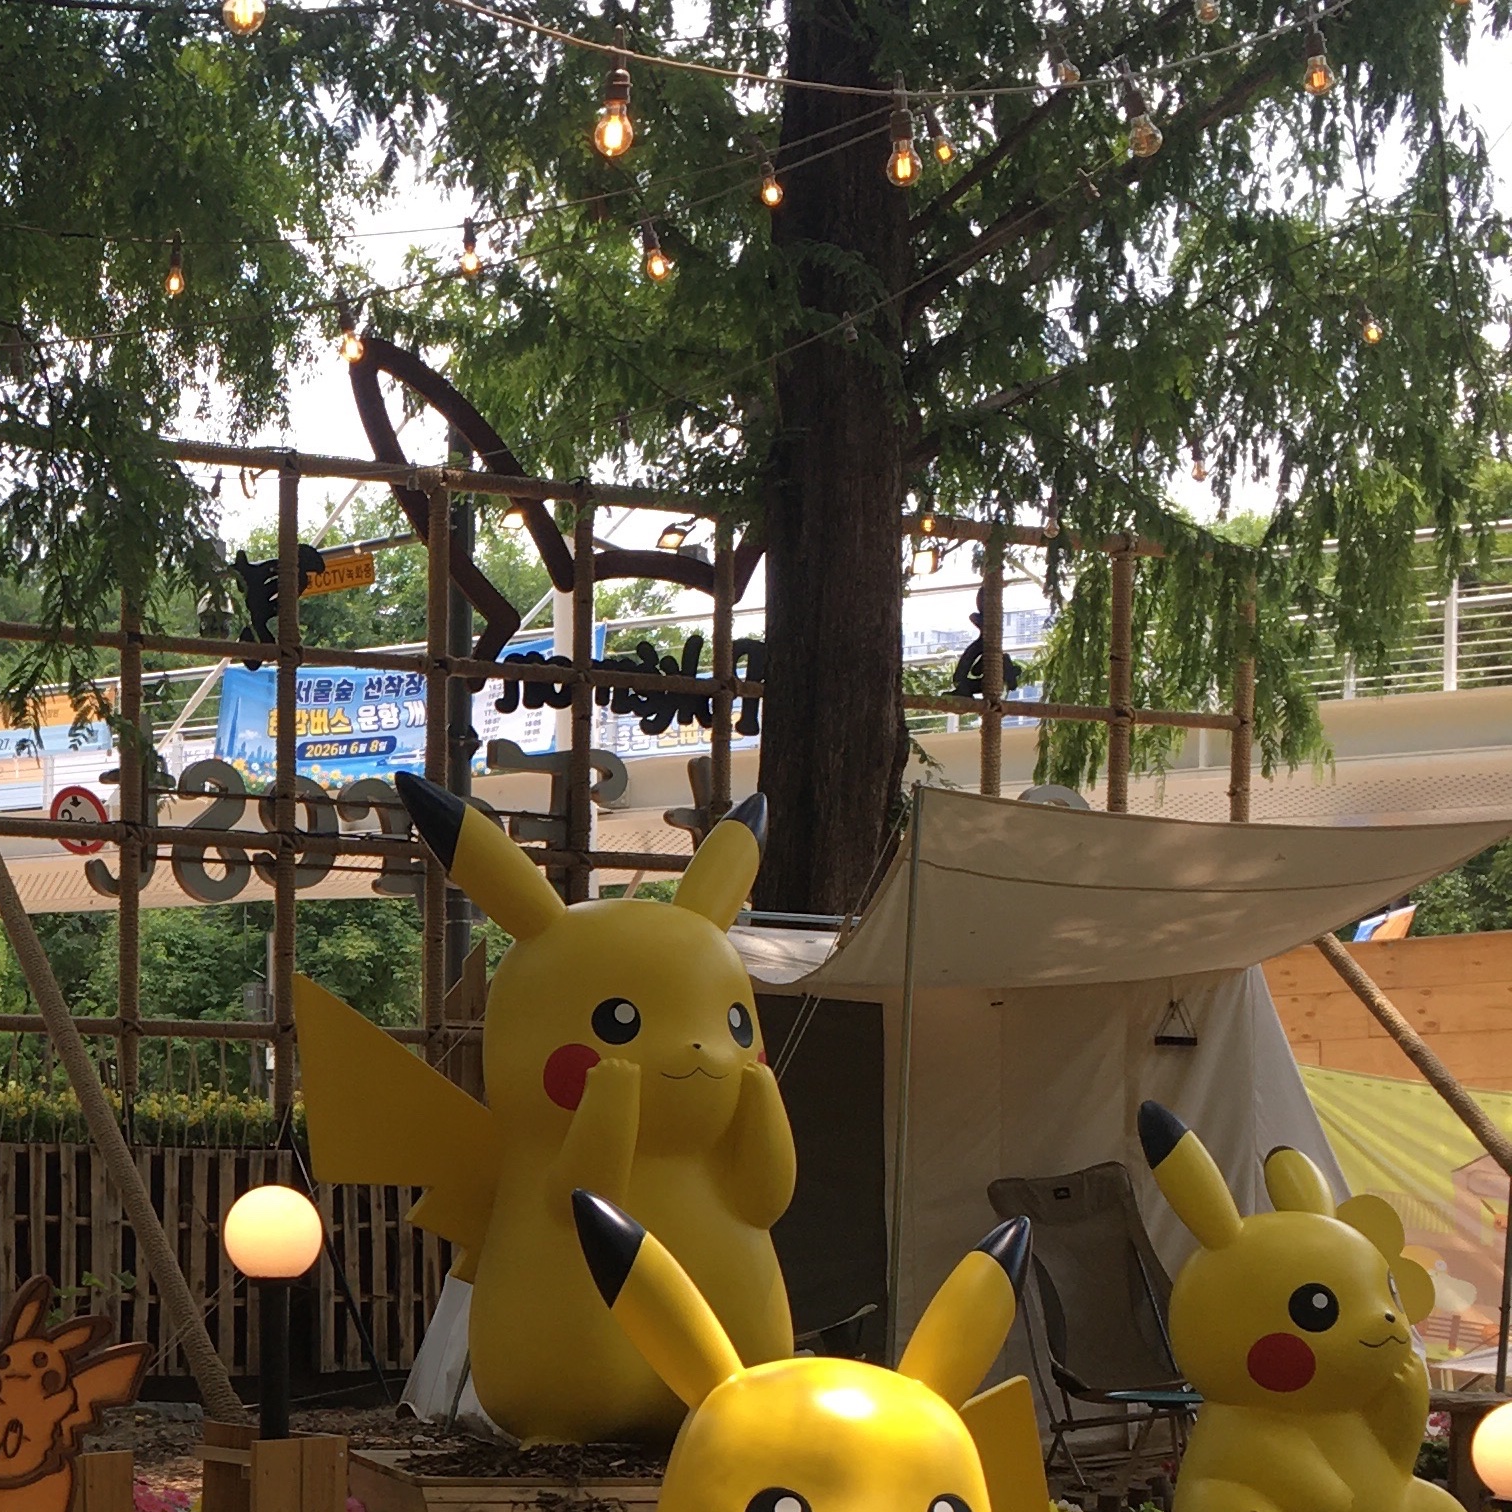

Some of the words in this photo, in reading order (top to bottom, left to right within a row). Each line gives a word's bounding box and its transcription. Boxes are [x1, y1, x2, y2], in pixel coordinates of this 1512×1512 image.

[296, 678, 354, 704] 서울숲
[364, 673, 425, 699] 선착장
[357, 703, 400, 732] 운항
[304, 743, 347, 758] 2026년
